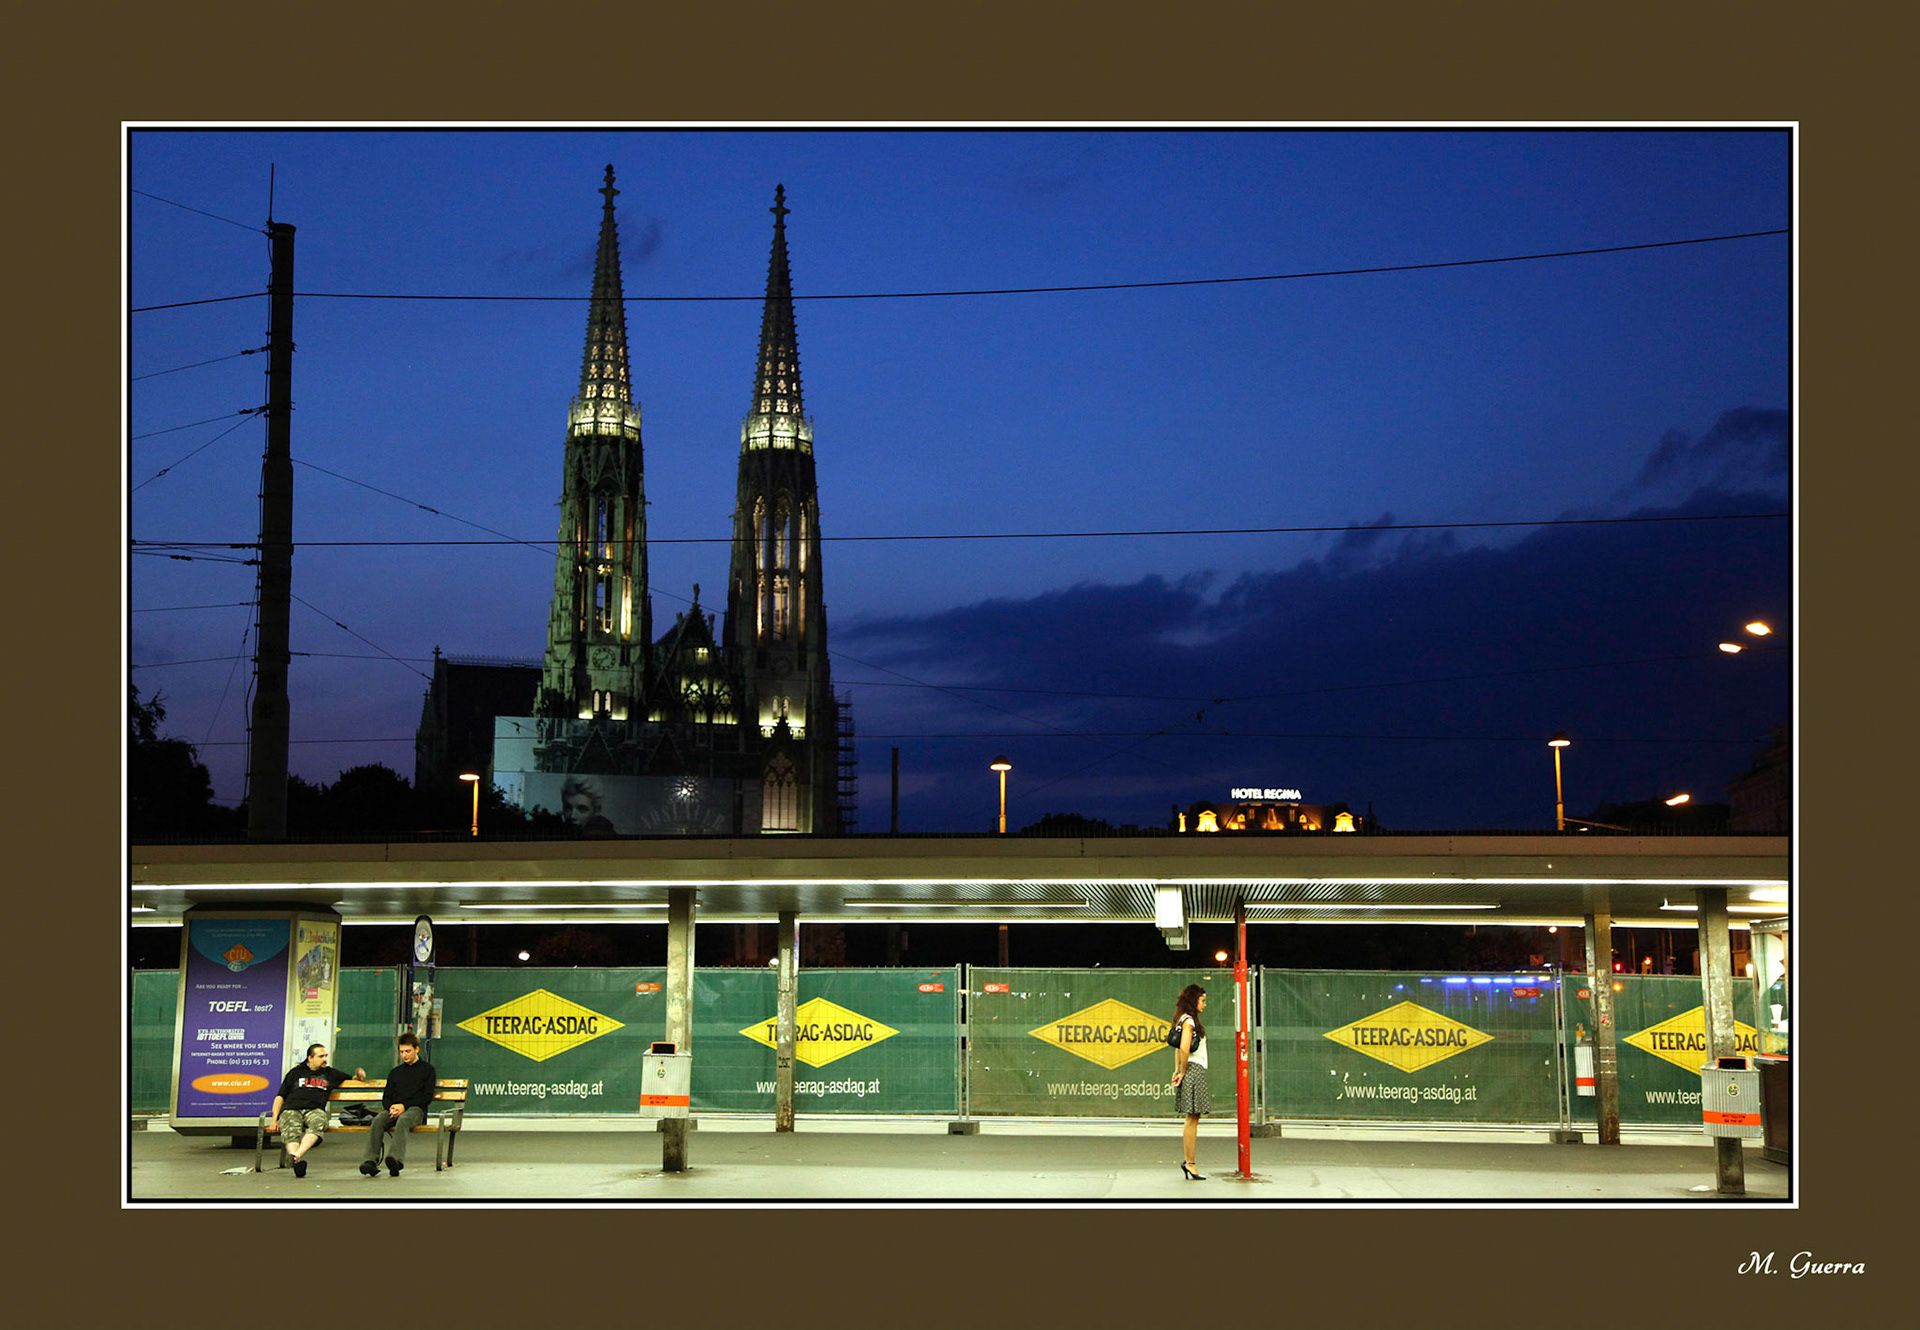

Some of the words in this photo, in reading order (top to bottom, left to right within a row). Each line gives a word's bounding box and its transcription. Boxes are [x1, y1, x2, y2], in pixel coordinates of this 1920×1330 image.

[1231, 788, 1263, 799] HOTEL
[1263, 788, 1302, 800] REGINA
[229, 949, 248, 960] CIU
[254, 1004, 274, 1012] test?
[485, 1016, 598, 1035] TEERAG-ASDAG
[767, 1024, 873, 1041] TRAG-ASDAG
[1057, 1025, 1168, 1043] TEERAG-ASDAG
[1352, 1027, 1468, 1047] TEERAG-ASDAG
[474, 1080, 604, 1098] www.teerag-asdag.at
[1048, 1080, 1176, 1100] www.teerag-asdag.at
[1345, 1084, 1477, 1104] www.teerag-asdag.at
